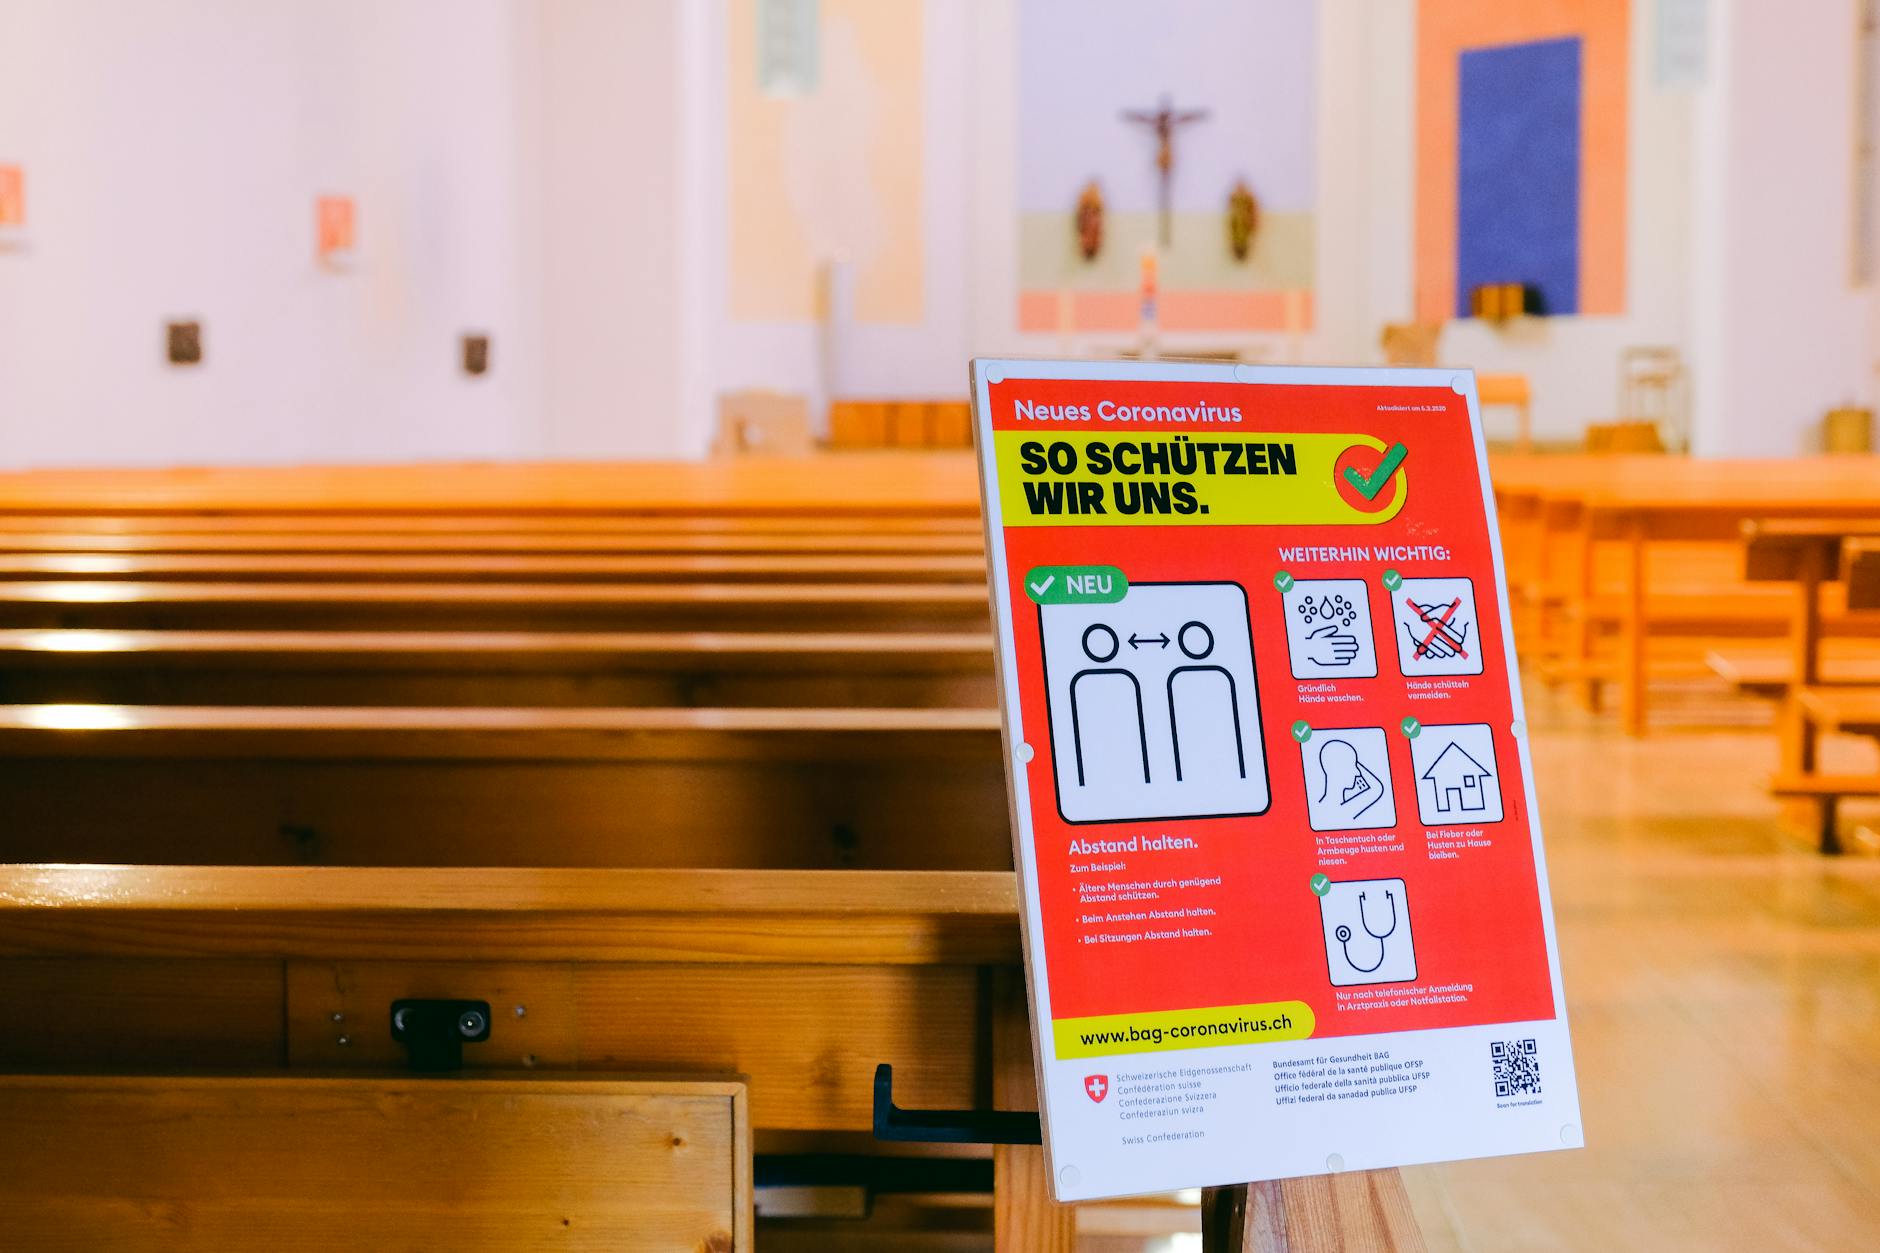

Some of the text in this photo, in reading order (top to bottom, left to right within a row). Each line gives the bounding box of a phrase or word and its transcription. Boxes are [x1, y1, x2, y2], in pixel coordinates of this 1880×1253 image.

[1014, 400, 1243, 423] Neues Coronavirus
[1020, 436, 1297, 476] SO SCHÜTZEN
[1023, 481, 1210, 514] WIR UNS.
[1279, 545, 1451, 562] WEITERHIN WICHTIG:
[1066, 575, 1112, 594] NEU
[1297, 684, 1336, 693] Gründlich
[1406, 681, 1469, 690] Hände schütteln
[1298, 693, 1364, 703] Hände waschen.
[1408, 691, 1451, 700] vermeiden.
[1315, 834, 1396, 845] In Taschentuch oder
[1426, 829, 1484, 839] Bei Fieber oder
[1068, 834, 1198, 855] Abstand halten.
[1317, 843, 1405, 857] Armbeuge husten und
[1427, 841, 1455, 850] Husten
[1467, 839, 1492, 848] Hause
[1318, 857, 1347, 866] niesen.
[1428, 851, 1460, 860] bleiben.
[1070, 861, 1126, 873] Zum Beispiel:
[1079, 876, 1222, 893] Ältere Menschen durch genügend
[1080, 891, 1160, 903] Abstand schützen.
[1082, 907, 1216, 924] Beim Anstehen Abstand halten.
[1084, 928, 1212, 944] Bei Sitzungen Abstand halten.
[1336, 983, 1473, 1001] Nur nach telefonischer Anmeldung
[1337, 994, 1468, 1011] in Arztpraxis oder Notfallstation.
[1080, 1013, 1292, 1046] www.bag-coronavirus.ch
[1272, 1051, 1390, 1069] Bundesamt für Gesundheit BAG
[1116, 1063, 1252, 1083] Schweizerische Eidgenossenschaft
[1274, 1060, 1424, 1080] Office fédéral de la santé publique OFSP
[1117, 1080, 1201, 1095] Confédération suisse
[1275, 1071, 1430, 1093] Ufficio federale della sanità pubblica UFSP
[1119, 1091, 1217, 1108] Confederazione Svizzera
[1276, 1085, 1418, 1105] Uffizi federal da sanadad publica UFSP
[1120, 1105, 1204, 1120] Confederaziun svizra
[1122, 1129, 1205, 1145] Swiss Confederation
